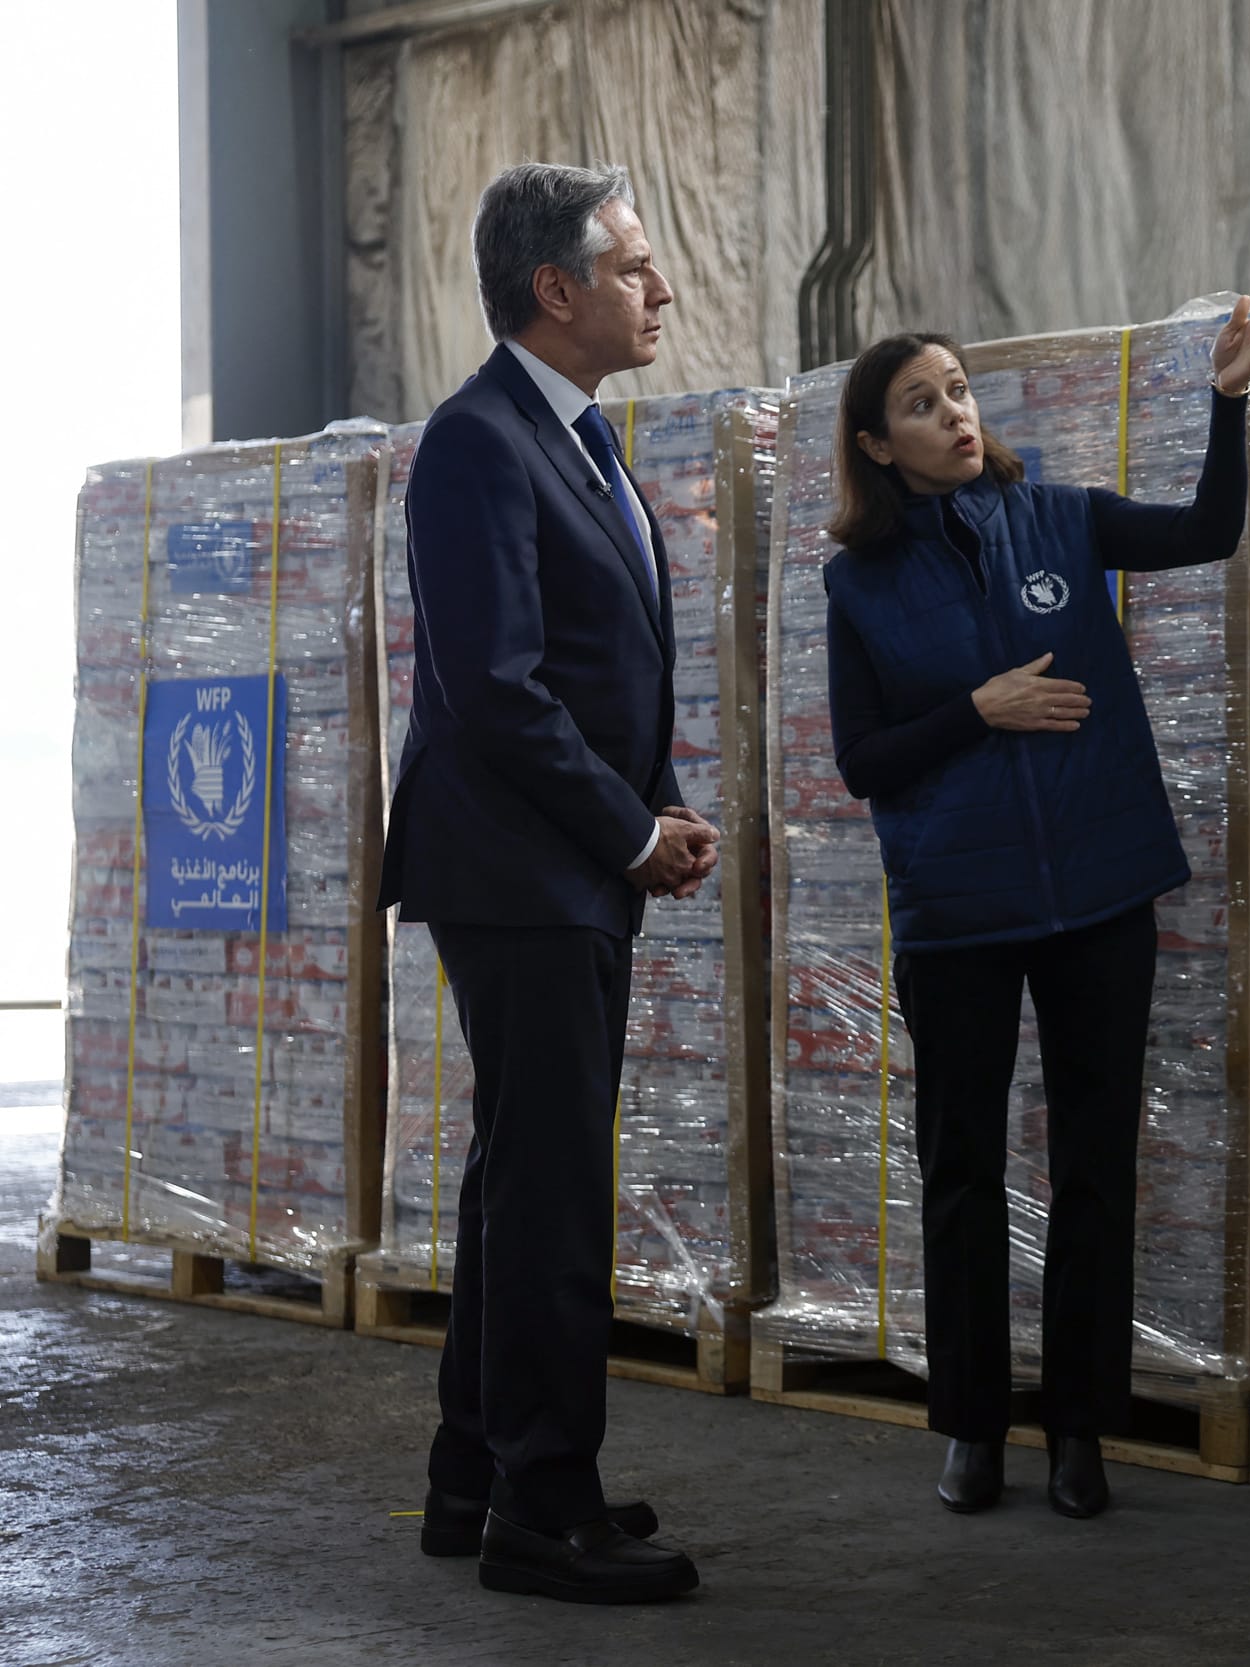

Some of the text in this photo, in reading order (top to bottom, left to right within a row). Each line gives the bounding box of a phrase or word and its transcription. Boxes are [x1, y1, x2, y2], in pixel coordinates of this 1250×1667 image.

[1025, 569, 1045, 583] WFP
[196, 687, 231, 712] WFP
[171, 856, 260, 890] برنامج الأغذية
[171, 888, 259, 918] العالمي
